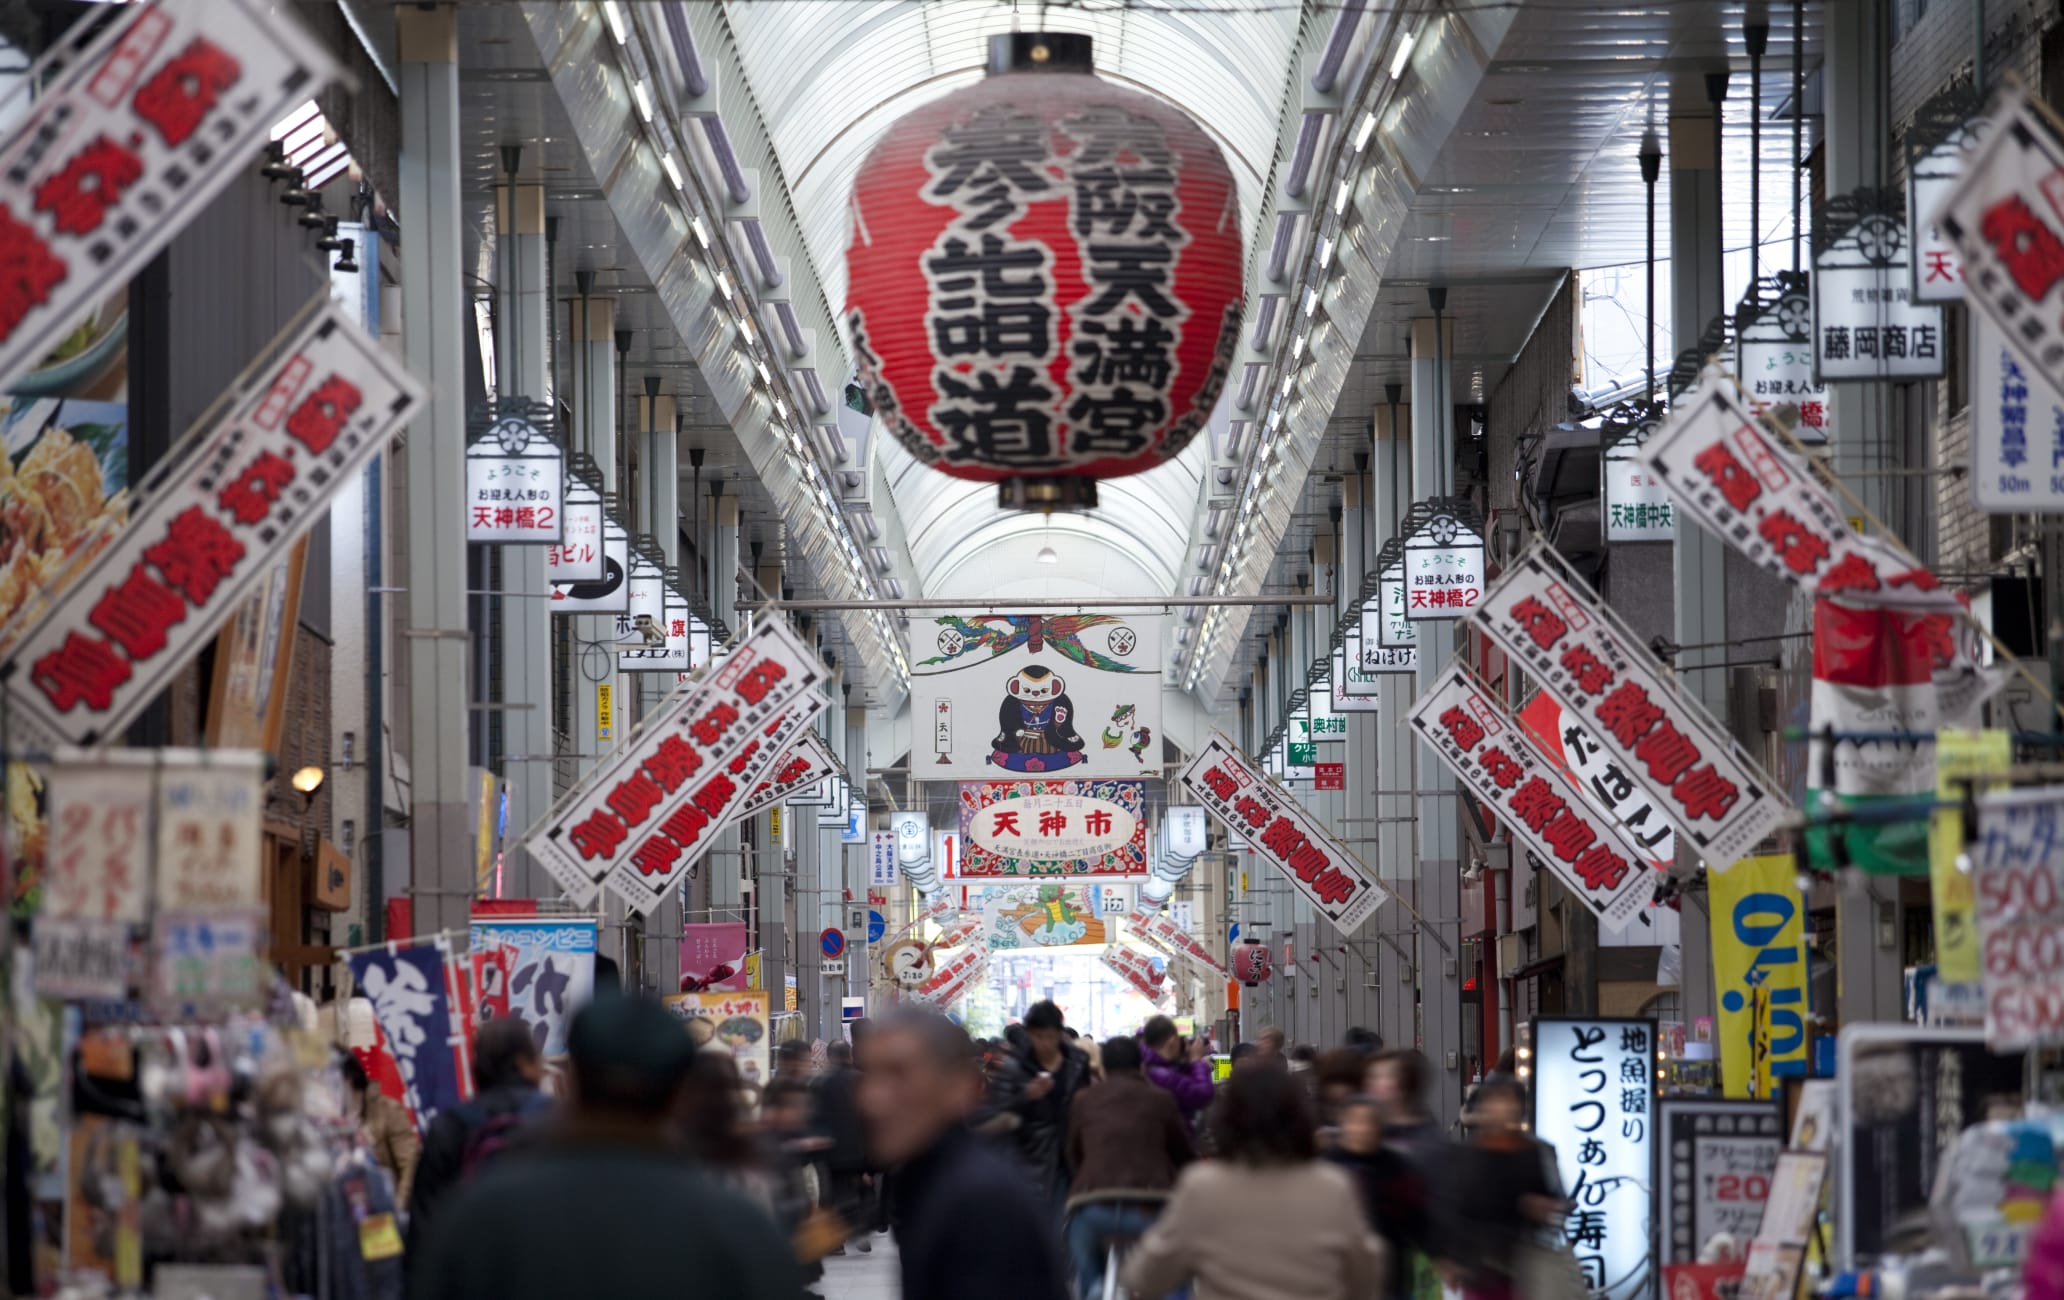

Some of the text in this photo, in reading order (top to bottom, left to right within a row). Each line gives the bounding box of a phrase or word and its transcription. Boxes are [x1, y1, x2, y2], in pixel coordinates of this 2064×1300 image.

[1056, 104, 1188, 456] 大阪天満宮
[1823, 324, 1937, 360] 藤岡商店
[487, 465, 541, 480] ようこそ
[1998, 475, 2030, 492] 50m
[477, 488, 550, 502] お迎え人形の
[472, 506, 555, 529] 天神橋2
[1611, 504, 1674, 528] 天神橋中央
[1421, 557, 1466, 568] ようこそ
[1414, 574, 1474, 585] お迎え人形の
[1411, 588, 1479, 609] 天神橋2
[1022, 798, 1083, 810] 毎月二十五日
[991, 810, 1113, 837] 天神市
[1619, 1026, 1648, 1144] 地魚握り
